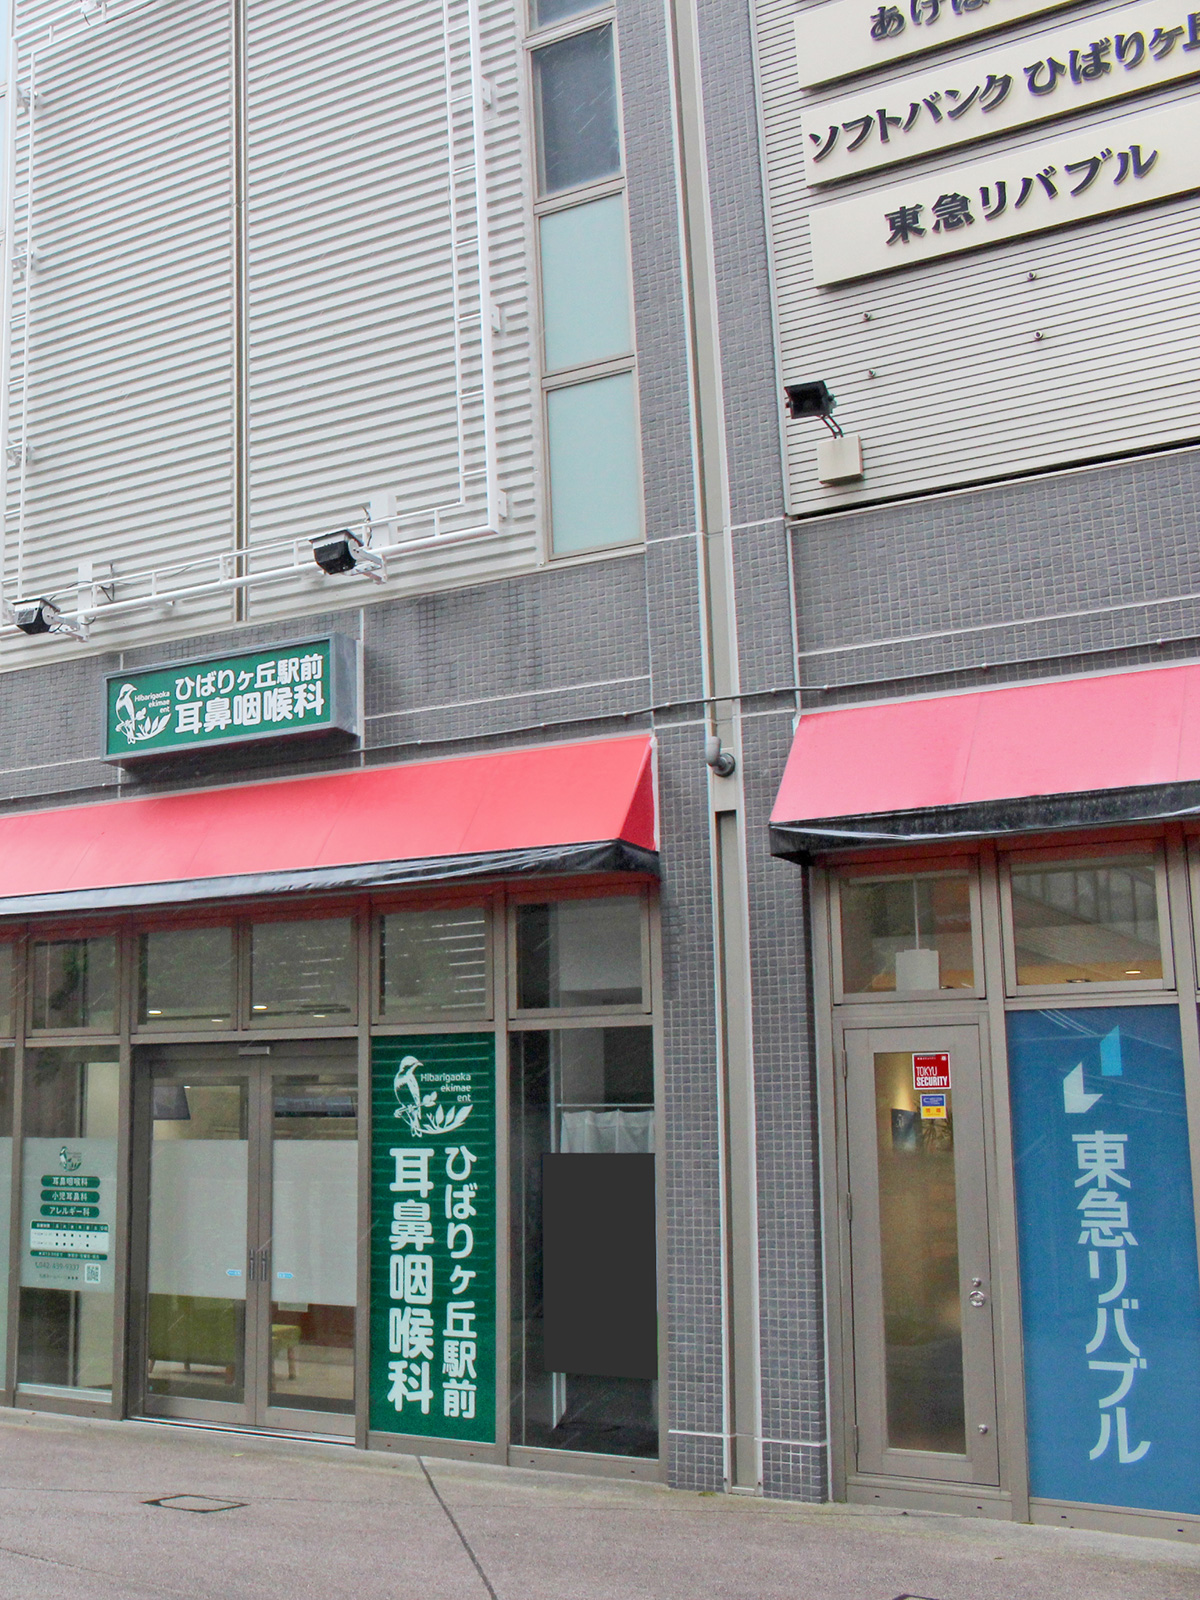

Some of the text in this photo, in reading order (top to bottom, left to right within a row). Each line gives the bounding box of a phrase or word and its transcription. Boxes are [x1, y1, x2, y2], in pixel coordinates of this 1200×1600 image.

[808, 73, 1014, 163] ソフトバンク
[884, 144, 1158, 246] 東急リバブル
[174, 681, 325, 734] 耳鼻咽喉科
[916, 1066, 938, 1076] TOKYU
[420, 1072, 471, 1083] Hibarigaoka
[916, 1076, 948, 1086] SECURITY
[440, 1083, 471, 1093] ekimae
[456, 1094, 471, 1102] ent
[49, 1206, 90, 1217] アレルギー科
[387, 1148, 434, 1415] 耳鼻咽喉科
[1072, 1130, 1151, 1464] 東急リバブル
